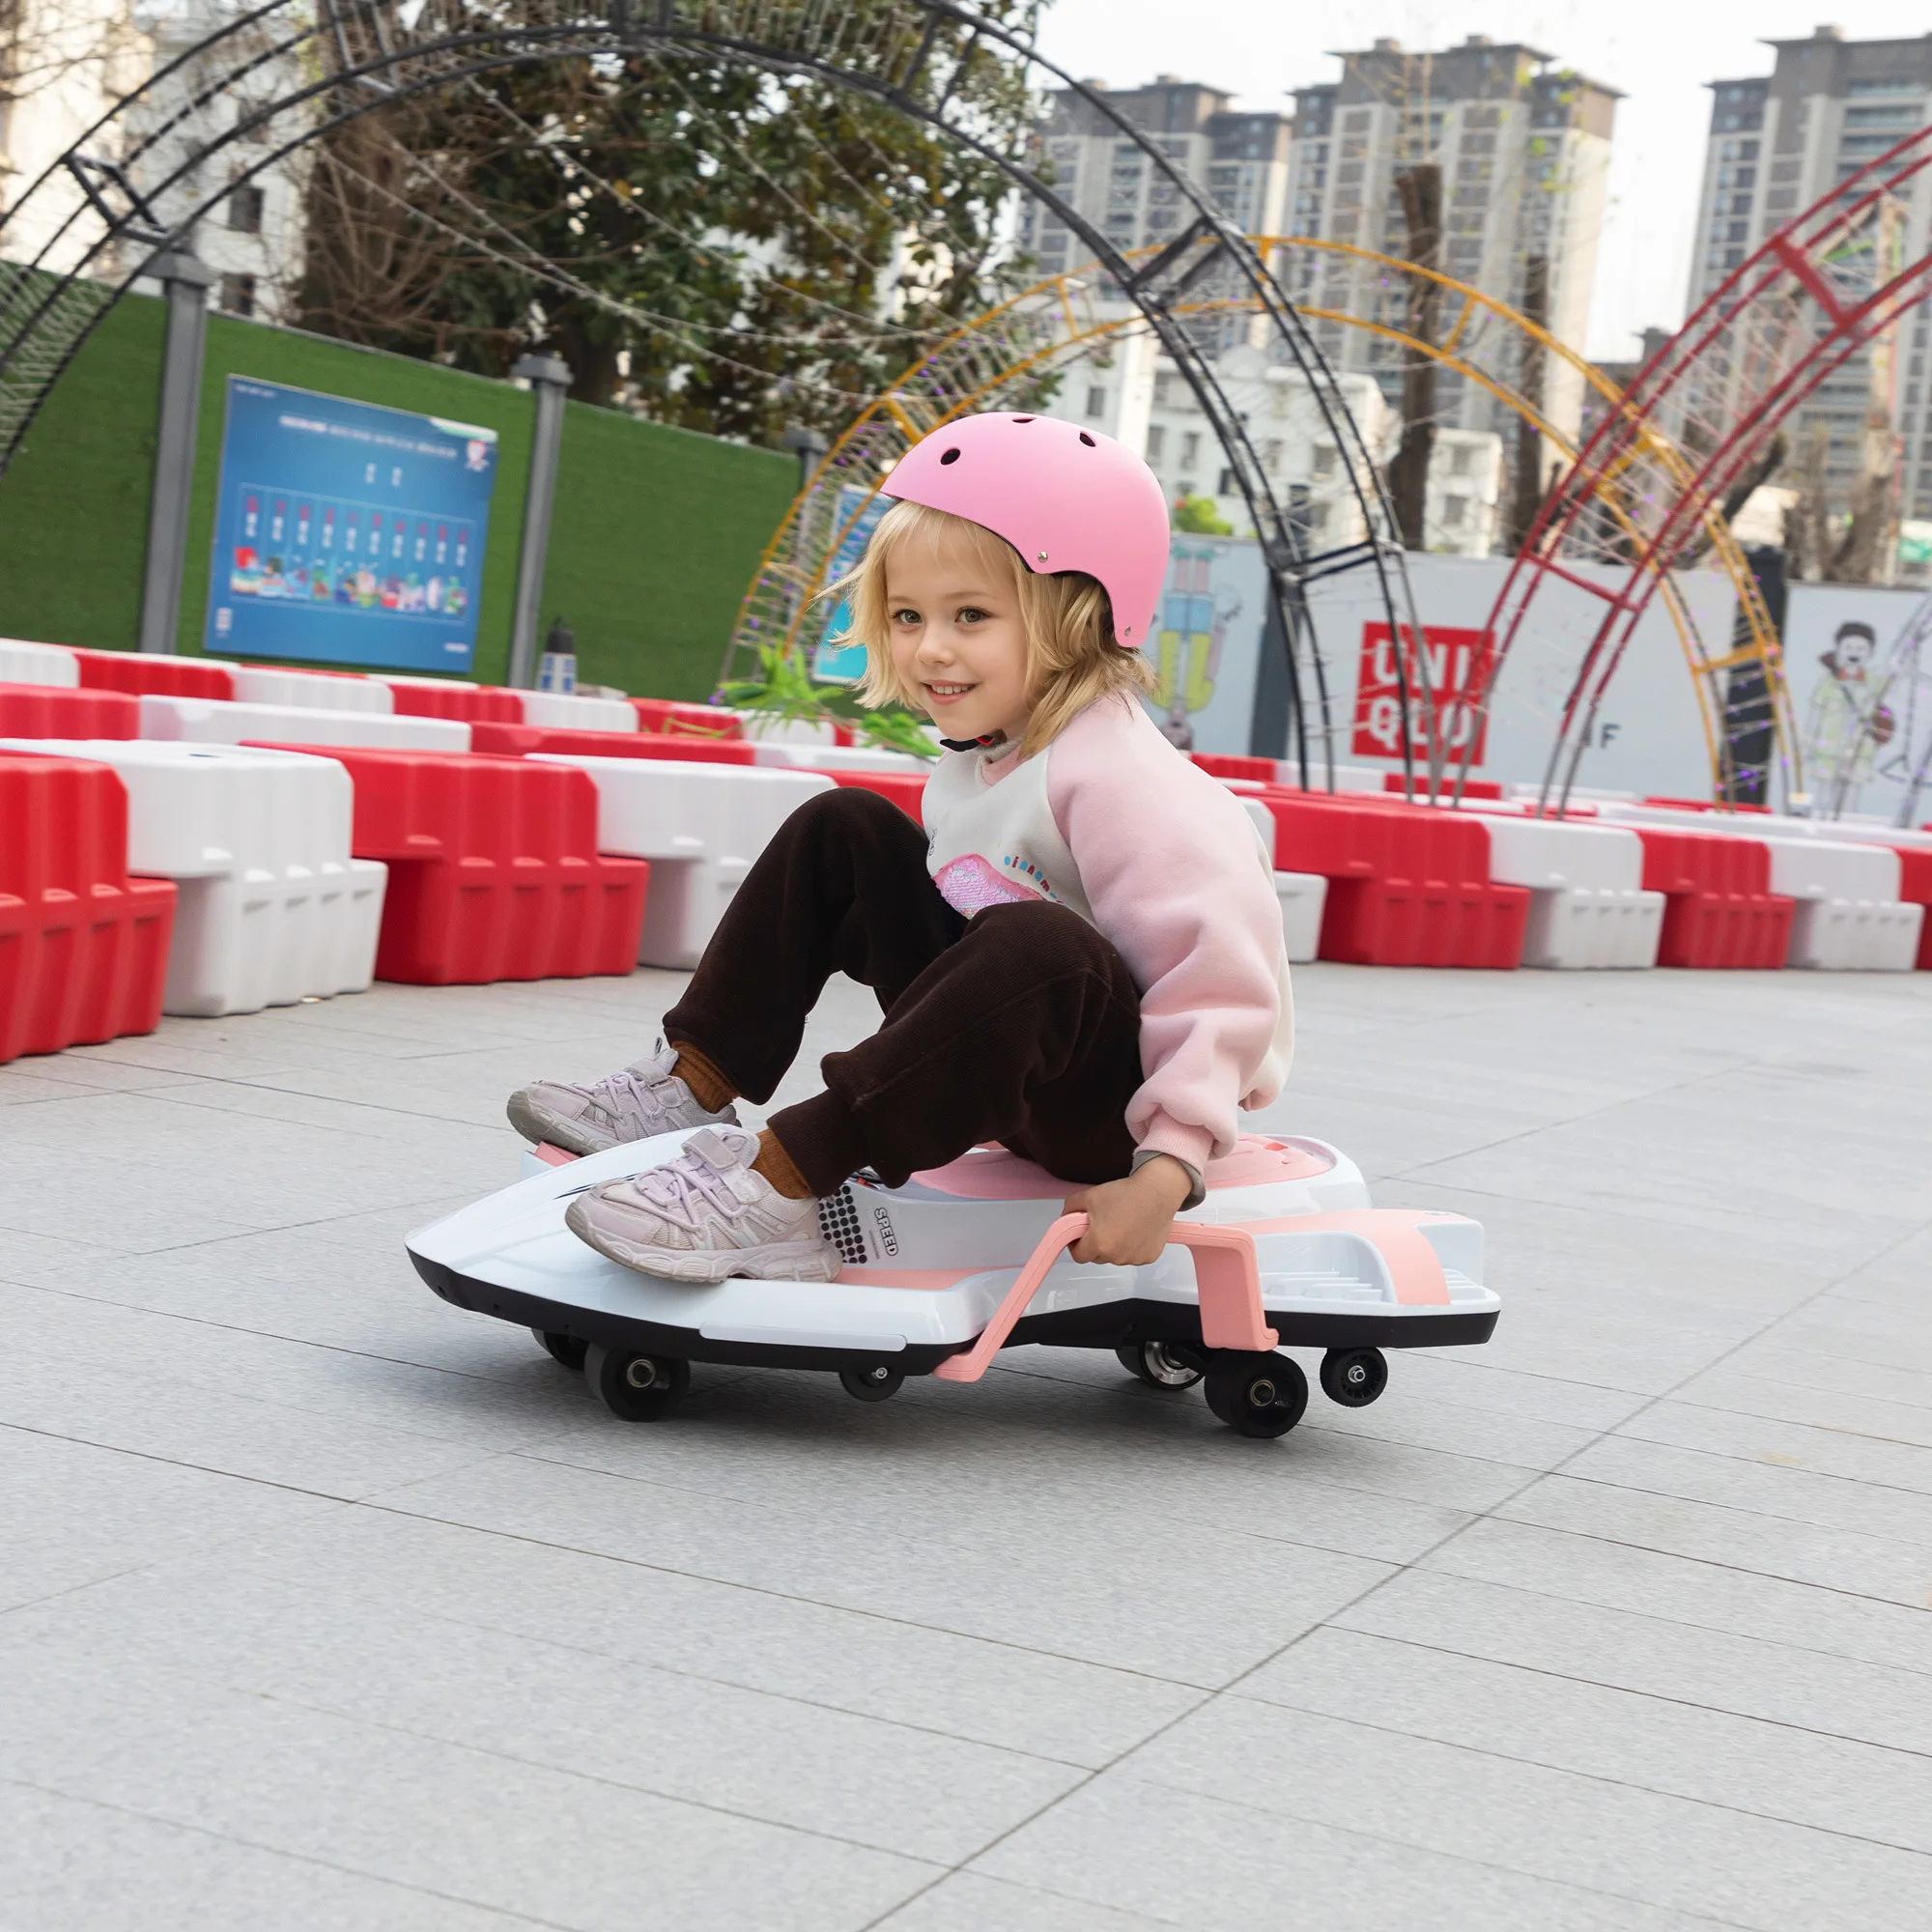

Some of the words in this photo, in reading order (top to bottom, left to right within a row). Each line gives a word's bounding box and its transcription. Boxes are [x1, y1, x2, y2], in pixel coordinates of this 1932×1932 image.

[1374, 639, 1470, 692] UNI
[1369, 696, 1473, 751] QLO
[874, 1207, 899, 1257] SPEED
